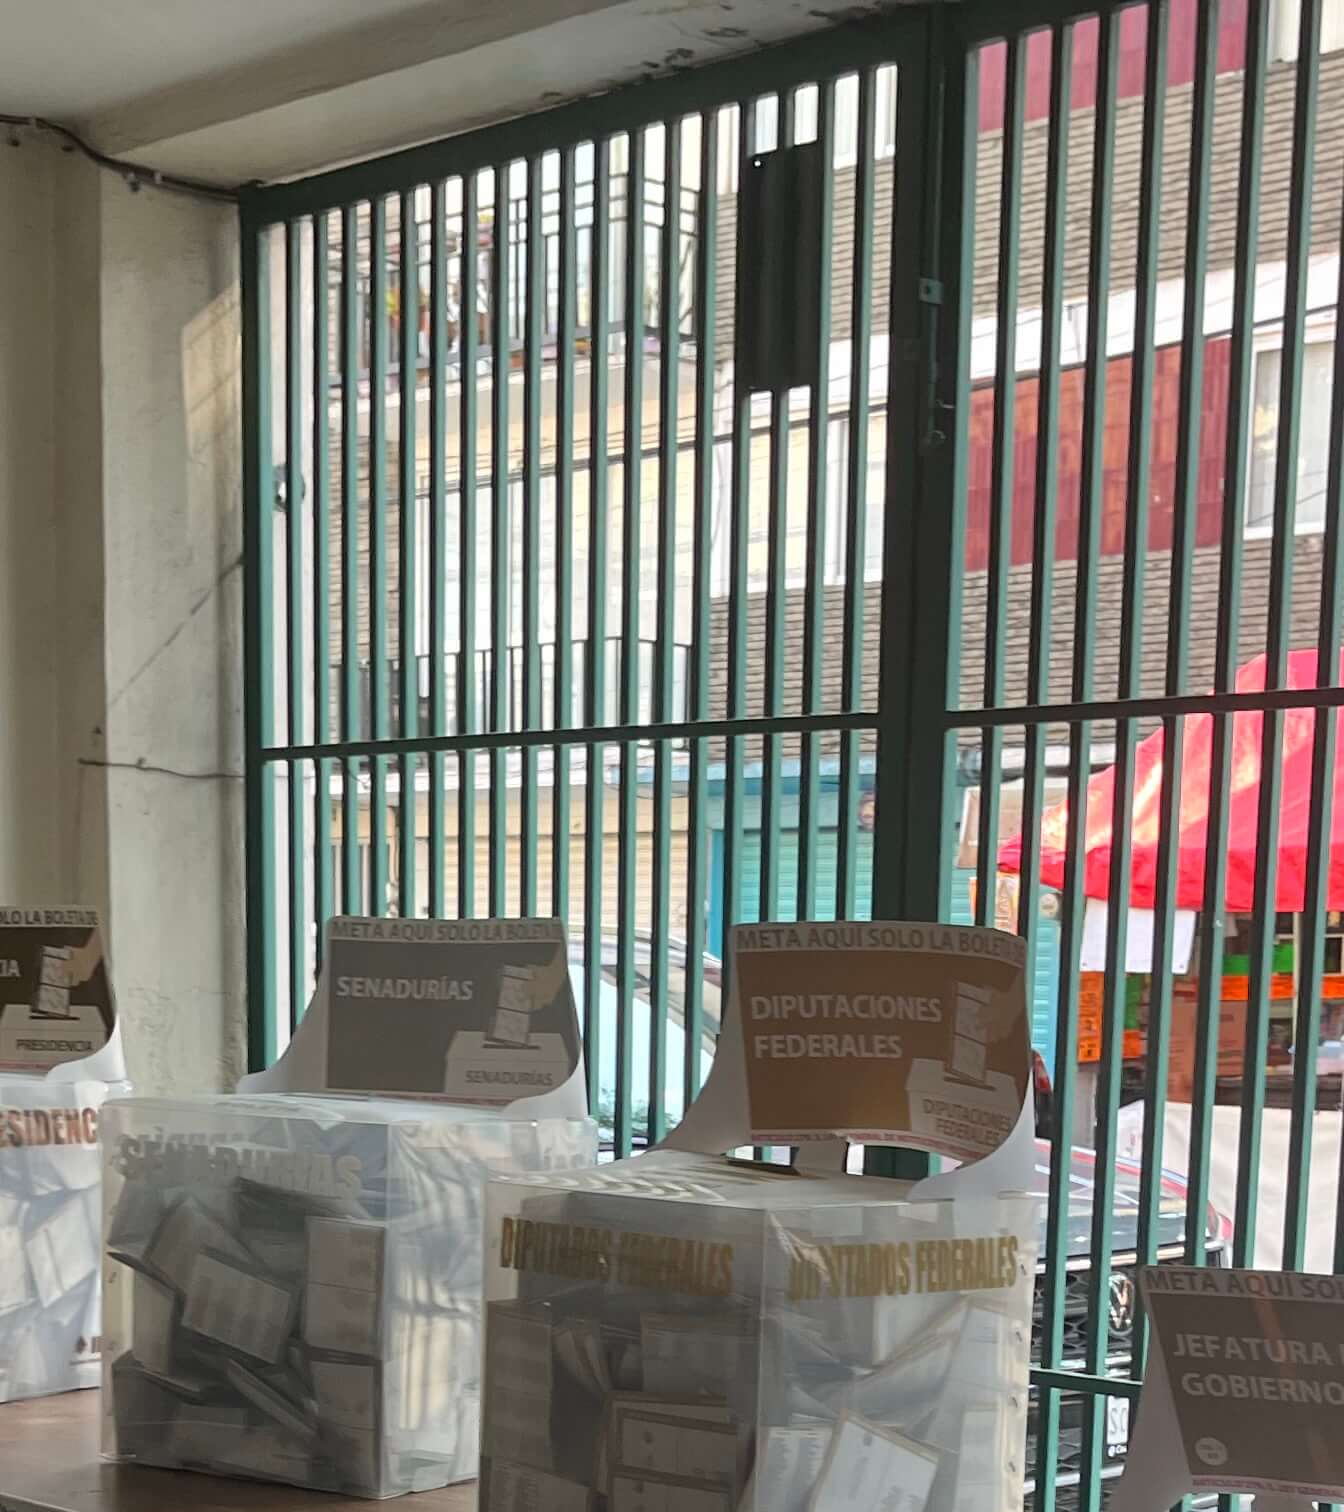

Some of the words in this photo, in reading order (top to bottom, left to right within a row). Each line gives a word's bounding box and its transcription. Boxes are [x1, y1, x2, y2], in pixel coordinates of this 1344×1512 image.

[333, 920, 385, 938] META
[438, 924, 480, 941] SOLO
[737, 928, 801, 949] META
[868, 928, 923, 950] SOLO
[928, 930, 954, 951] LA
[336, 974, 474, 1001] SENADURÍAS
[750, 994, 943, 1023] DIPUTACIONES
[754, 1034, 903, 1059] FEDERALES
[916, 1235, 1019, 1294] FEDERALES
[1145, 1269, 1219, 1294] META
[1172, 1332, 1334, 1368] JEFATURA
